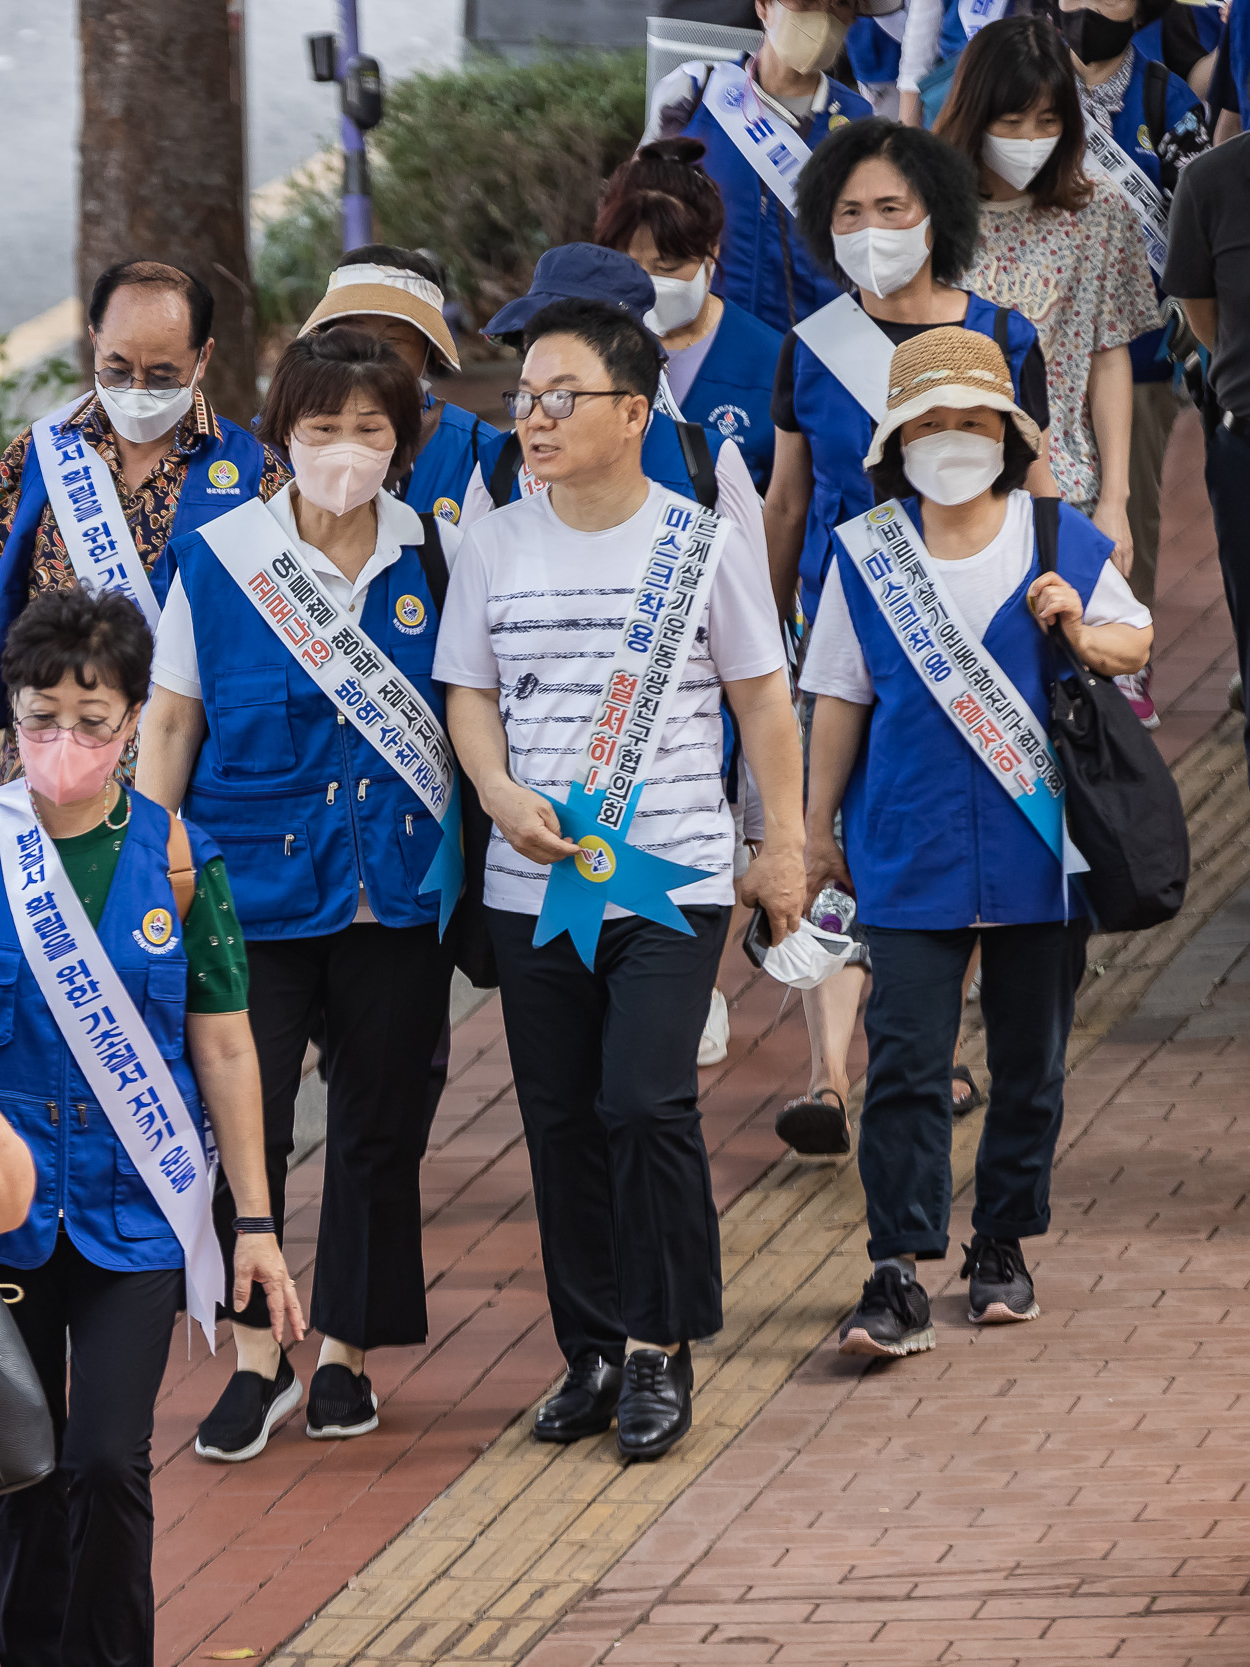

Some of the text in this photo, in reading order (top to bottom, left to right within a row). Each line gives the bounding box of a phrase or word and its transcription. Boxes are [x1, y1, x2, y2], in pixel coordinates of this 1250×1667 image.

[61, 464, 104, 523] 확립을
[82, 521, 119, 564] 위한
[247, 568, 334, 670] 코로나19
[271, 552, 338, 629] 여름철
[330, 626, 383, 679] 행락
[624, 504, 694, 653] 마스크착용
[861, 550, 953, 683] 마스크착용
[877, 522, 1067, 797] 바르게살기운동광진구협의회
[16, 825, 197, 1195] 법질서 확립을 위한 기초질서 지키기 운동
